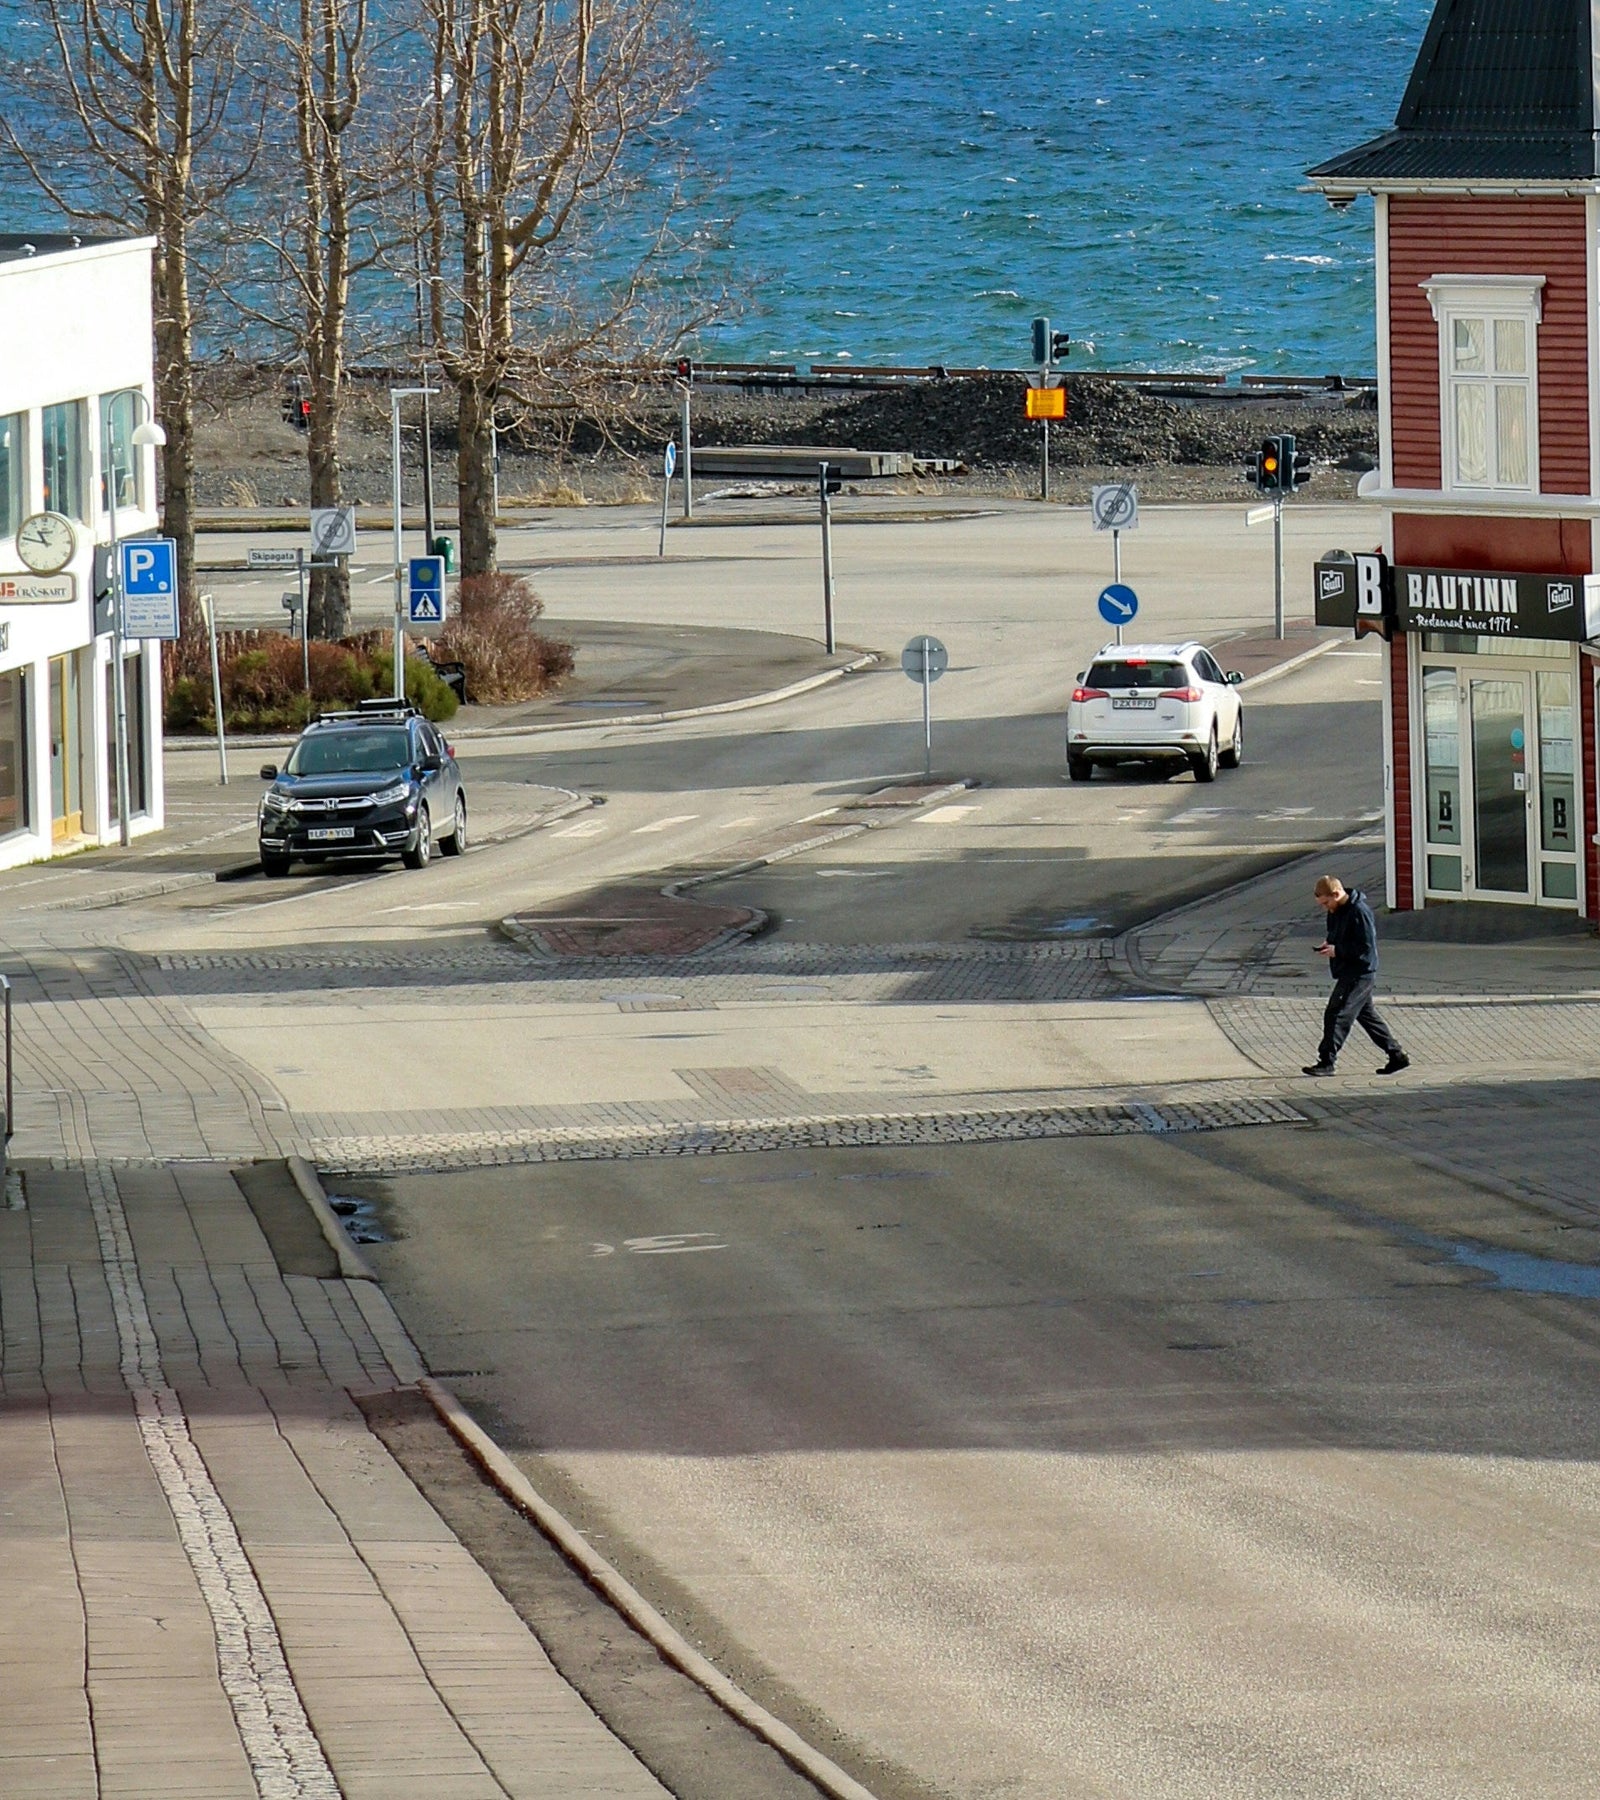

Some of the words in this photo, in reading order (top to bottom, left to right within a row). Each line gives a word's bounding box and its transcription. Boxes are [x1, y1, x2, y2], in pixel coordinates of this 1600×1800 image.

[130, 548, 155, 582] P
[251, 552, 295, 561] Skipagata
[1357, 556, 1381, 615] B
[1407, 573, 1518, 613] BAUTINN
[1551, 588, 1571, 604] Gull
[1415, 613, 1463, 630] Restaurant
[1465, 616, 1487, 630] since
[1488, 616, 1511, 633] 1971
[1438, 790, 1452, 821] B
[1552, 797, 1567, 828] B
